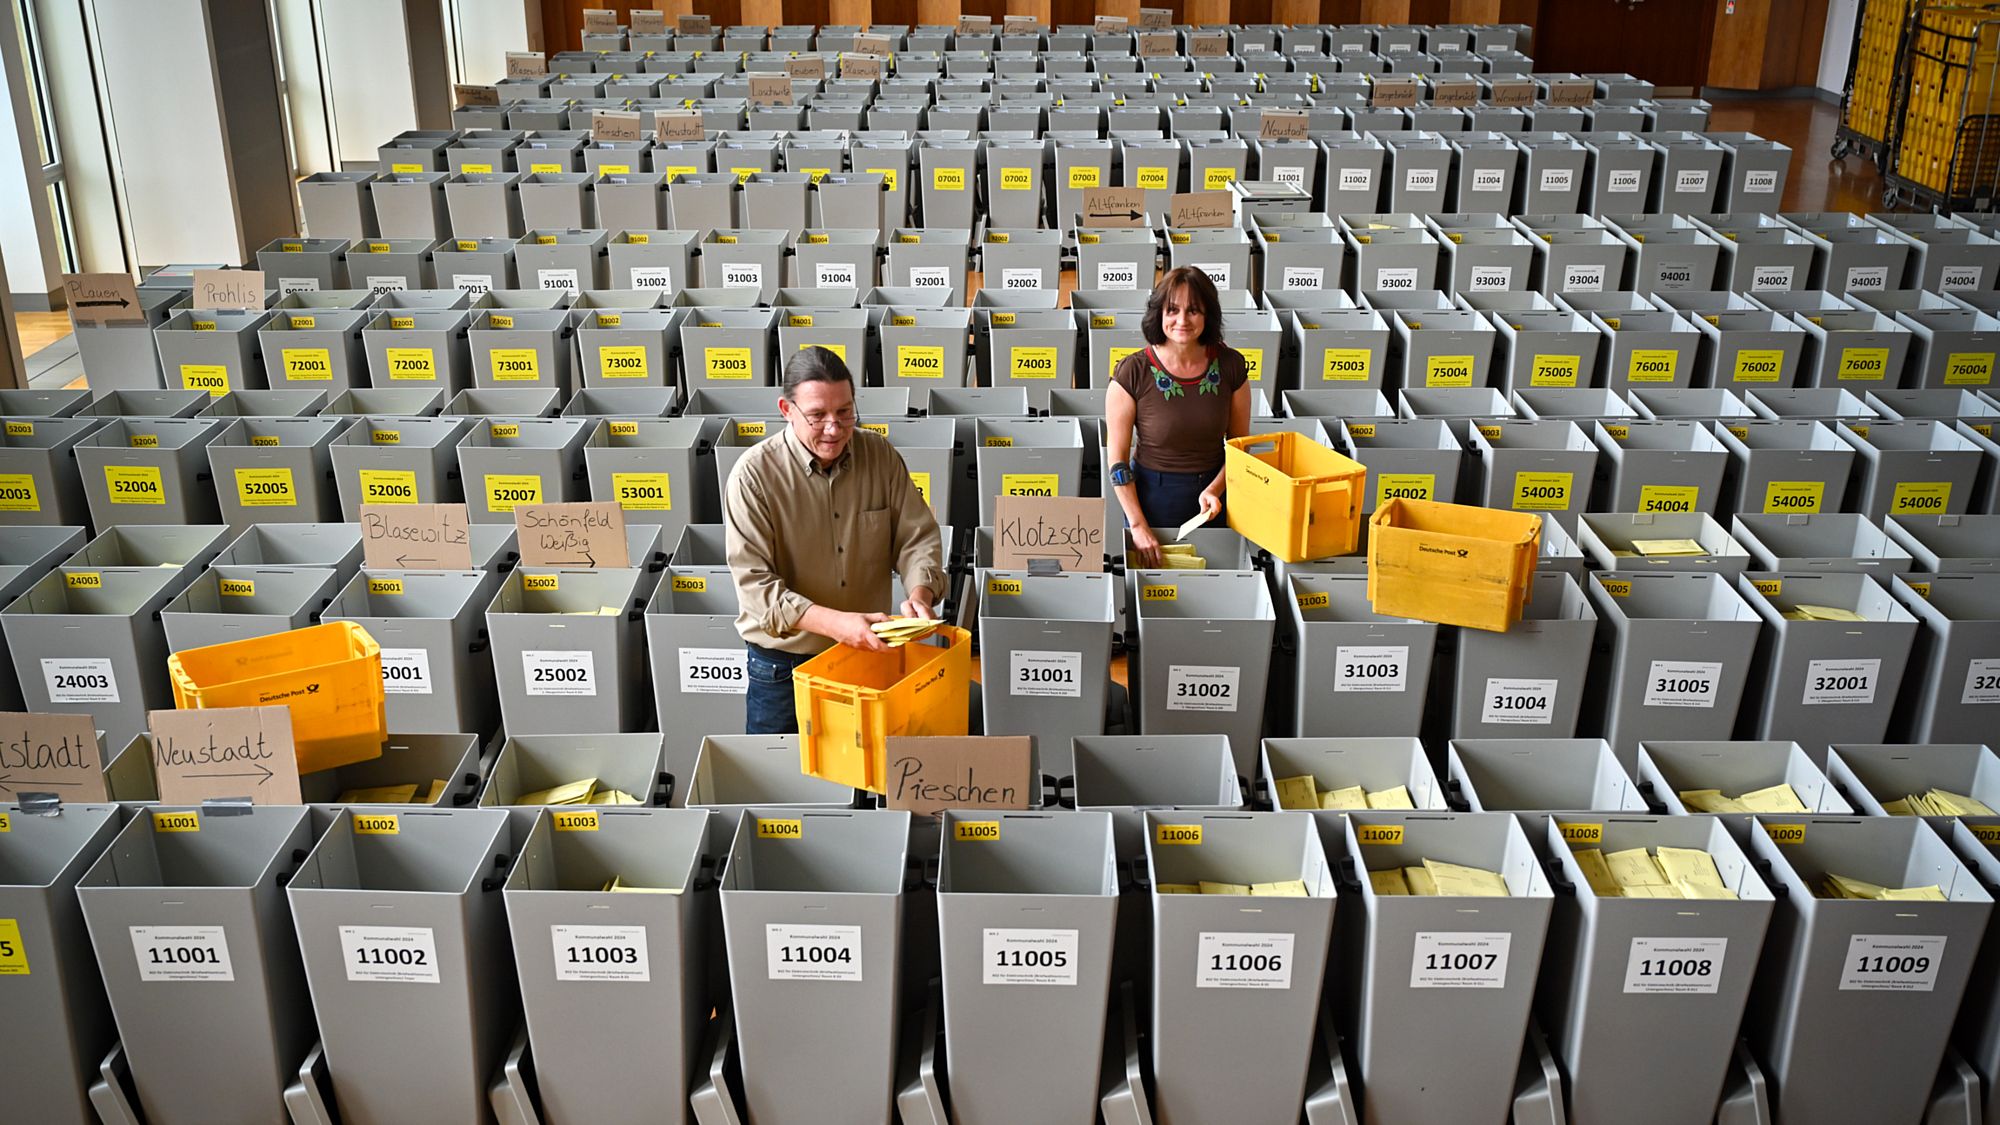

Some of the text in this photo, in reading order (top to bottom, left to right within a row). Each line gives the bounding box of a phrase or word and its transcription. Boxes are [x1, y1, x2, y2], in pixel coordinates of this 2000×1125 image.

[660, 122, 704, 138] Neustadt
[1262, 120, 1308, 136] Neustadt
[1072, 174, 1096, 182] 07003
[728, 273, 758, 283] 91003
[822, 273, 851, 283] 91004
[915, 277, 945, 286] 92001
[1103, 272, 1133, 282] 92003
[1208, 274, 1226, 282] 004
[1476, 276, 1506, 286] 93003
[1569, 275, 1599, 285] 93004
[1660, 272, 1690, 281] 94001
[1757, 276, 1787, 286] 94002
[1851, 277, 1881, 286] 94003
[1945, 277, 1975, 286] 94004
[544, 280, 573, 288] 91001
[637, 277, 666, 287] 91002
[1007, 278, 1037, 288] 92002
[1288, 277, 1318, 287] 93001
[1382, 279, 1412, 288] 93002
[204, 283, 256, 304] Prohlis
[492, 318, 511, 326] 73001
[290, 361, 325, 371] 72001
[394, 360, 429, 370] 72002
[497, 361, 533, 371] 73001
[607, 358, 641, 368] 73002
[712, 360, 746, 369] 73003
[904, 358, 938, 368] 74002
[1017, 359, 1051, 369] 74003
[1330, 361, 1364, 371] 75003
[1636, 362, 1670, 372] 76001
[1741, 362, 1776, 372] 76002
[1846, 360, 1880, 370] 76003
[1433, 368, 1467, 377] 75004
[1538, 367, 1573, 377] 75005
[1952, 365, 1986, 374] 76004
[189, 377, 224, 387] 71000
[115, 481, 157, 493] 52004
[245, 482, 288, 494] 52005
[369, 485, 411, 497] 52006
[0, 488, 31, 500] 2003
[494, 489, 536, 501] 52007
[621, 488, 664, 498] 53001
[1384, 489, 1426, 499] 54002
[1521, 487, 1564, 498] 54003
[1646, 500, 1688, 512] 54004
[1772, 495, 1814, 507] 54005
[1899, 497, 1942, 508] 54006
[364, 513, 467, 544] Blasewitz
[1001, 515, 1101, 548] Klotzsche
[1419, 546, 1443, 554] Deutsche
[70, 576, 98, 585] 24003
[527, 579, 555, 587] 25002
[676, 581, 704, 589] 25003
[224, 584, 252, 593] 24004
[372, 583, 400, 591] 25001
[992, 583, 1020, 592] 31001
[1146, 589, 1174, 597] 31002
[1298, 596, 1327, 605] 31003
[382, 667, 422, 680] 5001
[534, 668, 587, 682] 25002
[690, 666, 742, 680] 25003
[1020, 668, 1073, 682] 31001
[1345, 664, 1398, 678] 31003
[54, 674, 108, 688] 24003
[1656, 678, 1710, 693] 31005
[1814, 676, 1868, 690] 32001
[1973, 676, 2000, 689] 320
[1177, 683, 1230, 697] 31002
[260, 693, 290, 702] Deutsche
[1493, 696, 1546, 710] 31004
[0, 731, 90, 770] tstadt
[157, 732, 273, 766] Neustadt
[895, 757, 1015, 804] Pieschen
[160, 818, 196, 828] 11001
[358, 820, 395, 830] 11002
[559, 817, 596, 827] 11003
[762, 824, 798, 834] 11004
[960, 827, 997, 836] 11005
[1562, 829, 1599, 838] 11008
[1161, 830, 1199, 840] 11006
[1363, 830, 1401, 840] 11007
[148, 948, 220, 963] 11001
[356, 948, 427, 965] 11002
[568, 947, 637, 963] 11003
[781, 946, 851, 963] 11004
[997, 951, 1067, 966] 11005
[1211, 955, 1281, 971] 11006
[1426, 954, 1497, 970] 11007
[1857, 956, 1930, 973] 11009
[1640, 960, 1711, 976] 11008
